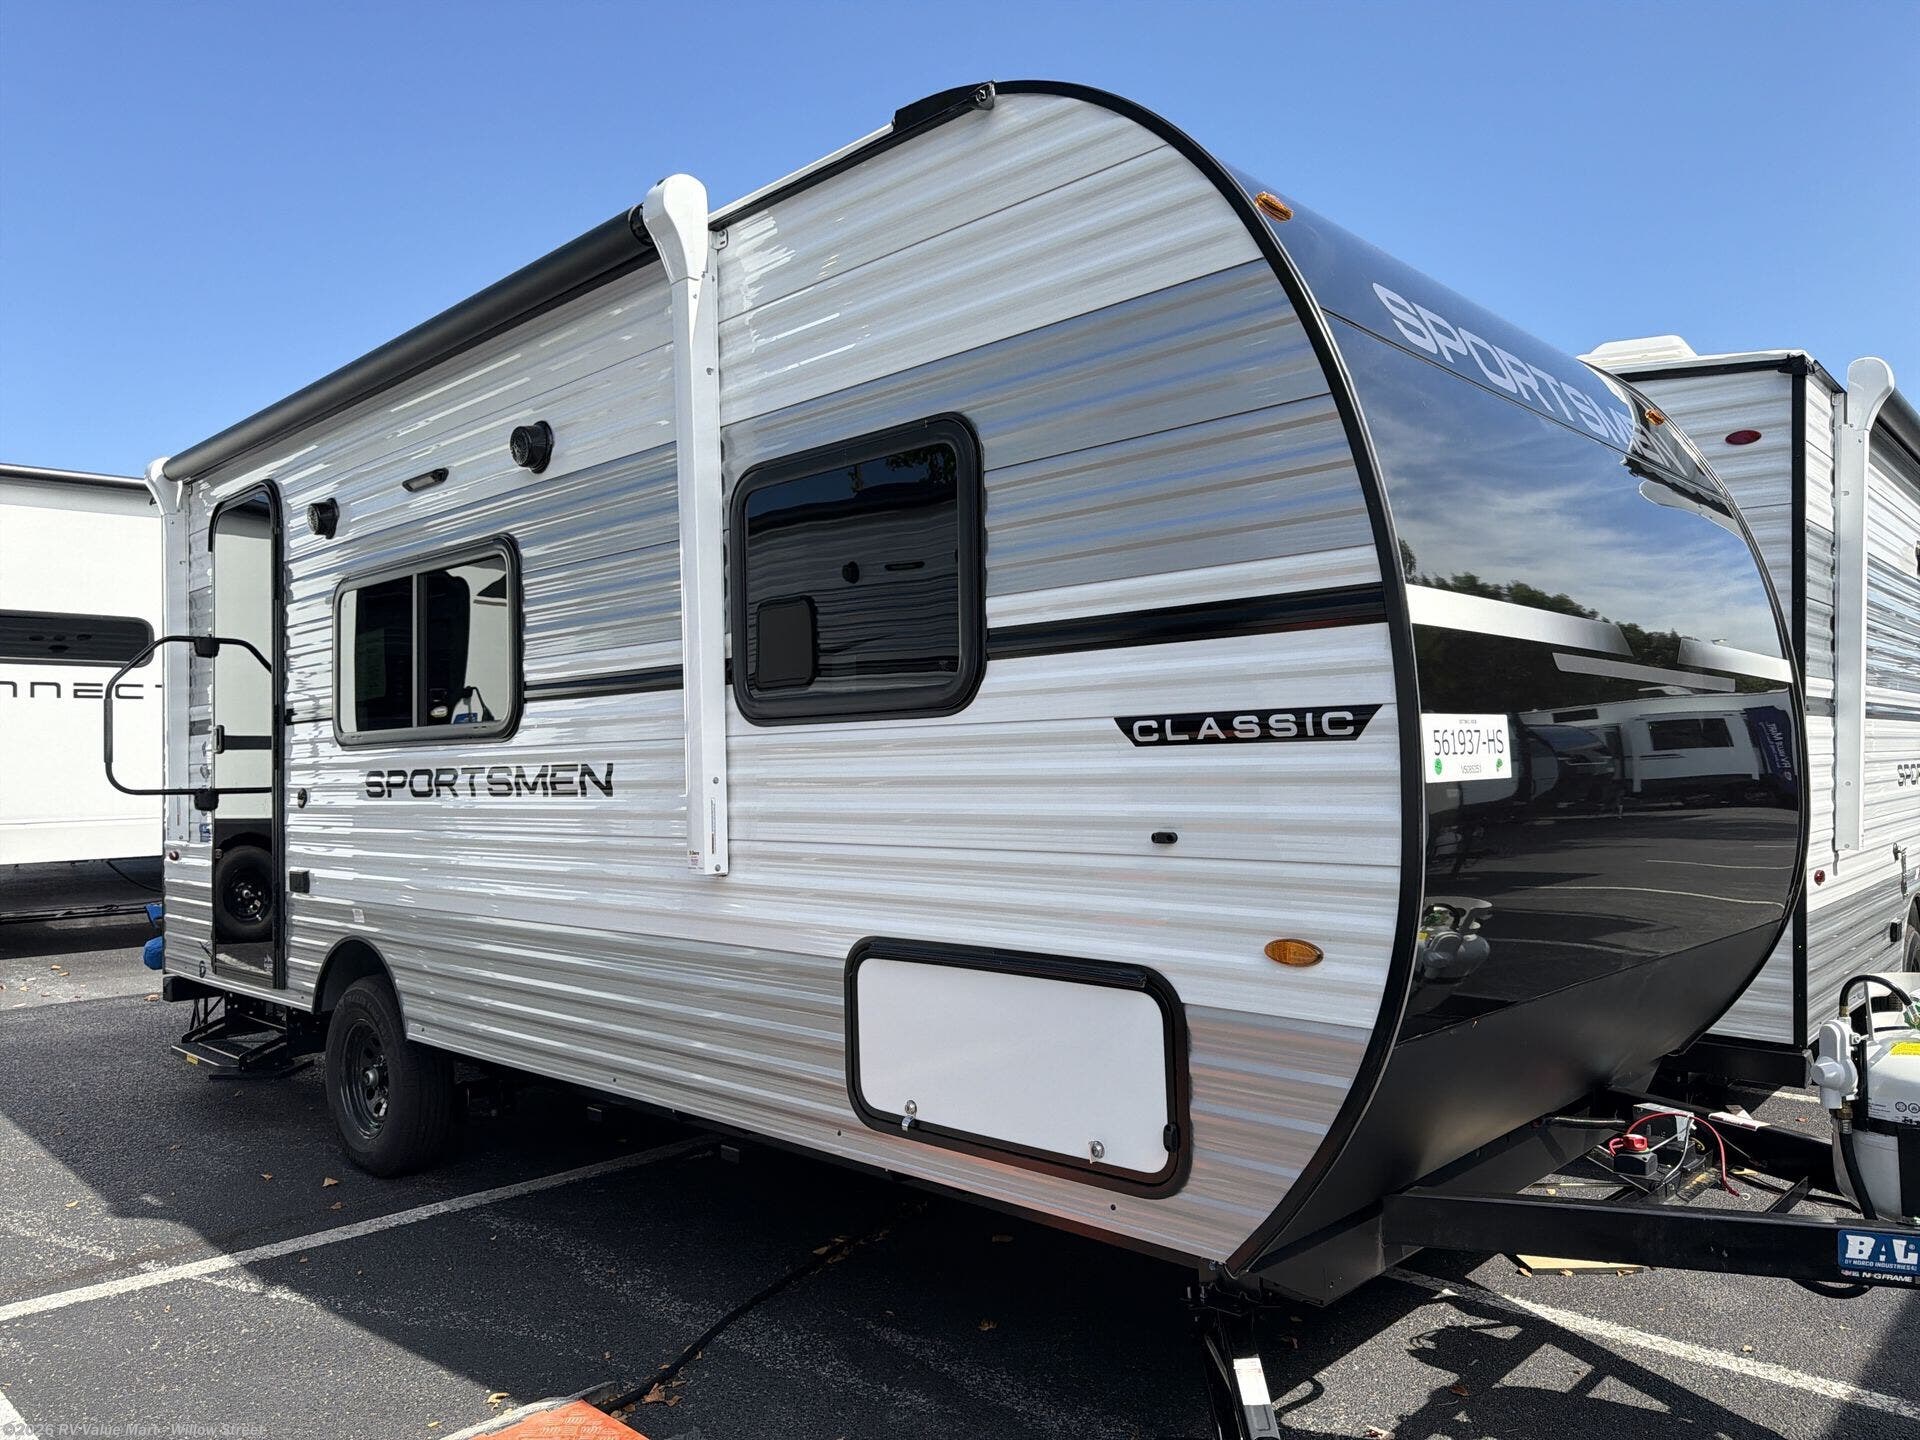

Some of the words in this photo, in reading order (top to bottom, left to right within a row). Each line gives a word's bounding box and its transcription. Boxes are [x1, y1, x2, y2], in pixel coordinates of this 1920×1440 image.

[1372, 282, 1689, 478] SPORTSMEN
[1133, 711, 1355, 742] CLASSIC
[1433, 729, 1504, 755] 561937-HS
[365, 763, 614, 797] SPORTSMEN
[1845, 1235, 1918, 1264] BAL
